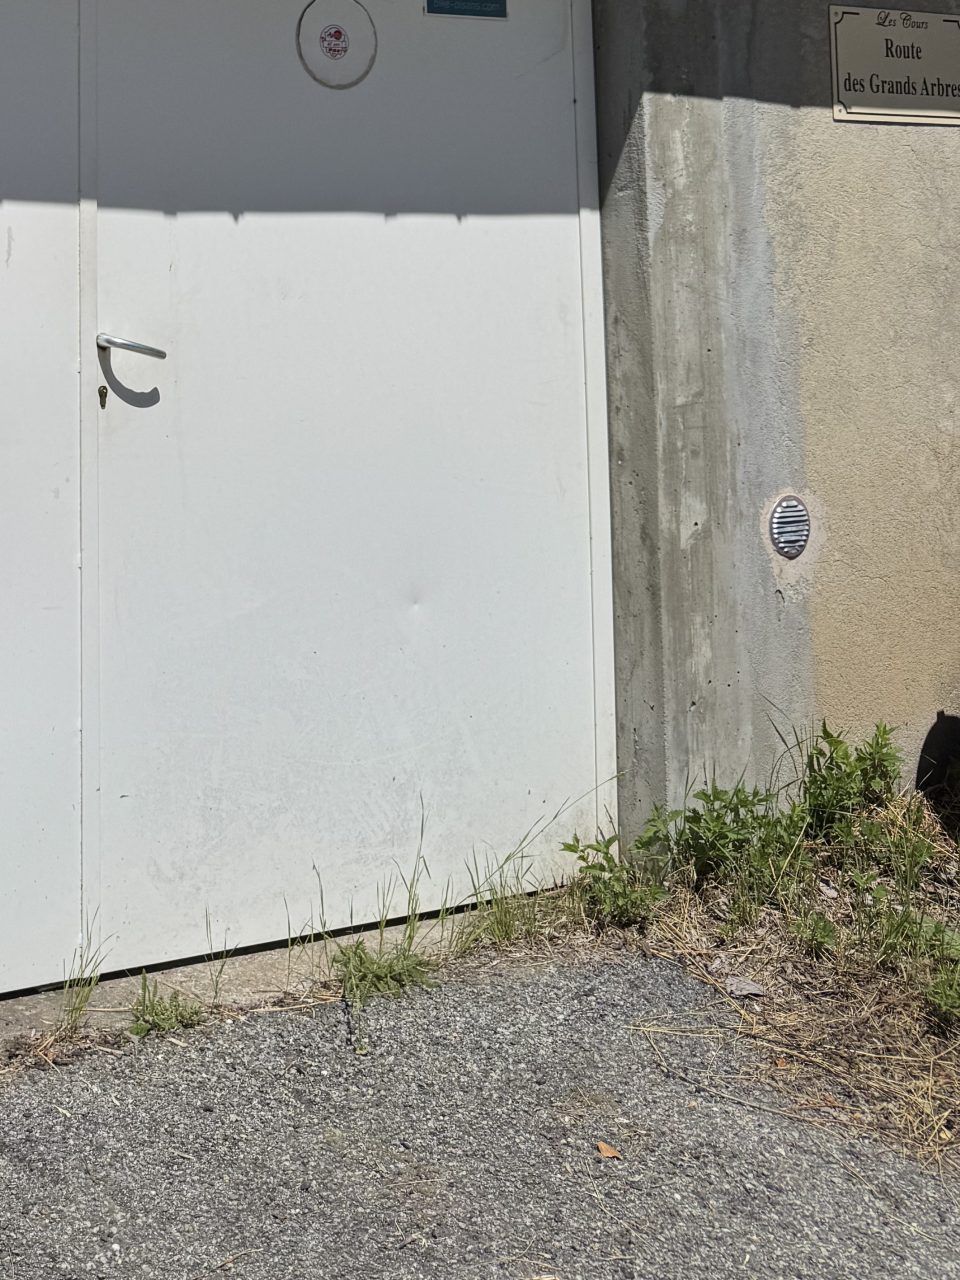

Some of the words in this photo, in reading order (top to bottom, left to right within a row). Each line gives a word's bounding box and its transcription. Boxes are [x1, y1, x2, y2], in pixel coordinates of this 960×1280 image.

[875, 10, 897, 27] Les
[900, 12, 929, 29] Cours
[884, 38, 922, 60] Route
[844, 72, 865, 93] des
[869, 73, 917, 96] Grands
